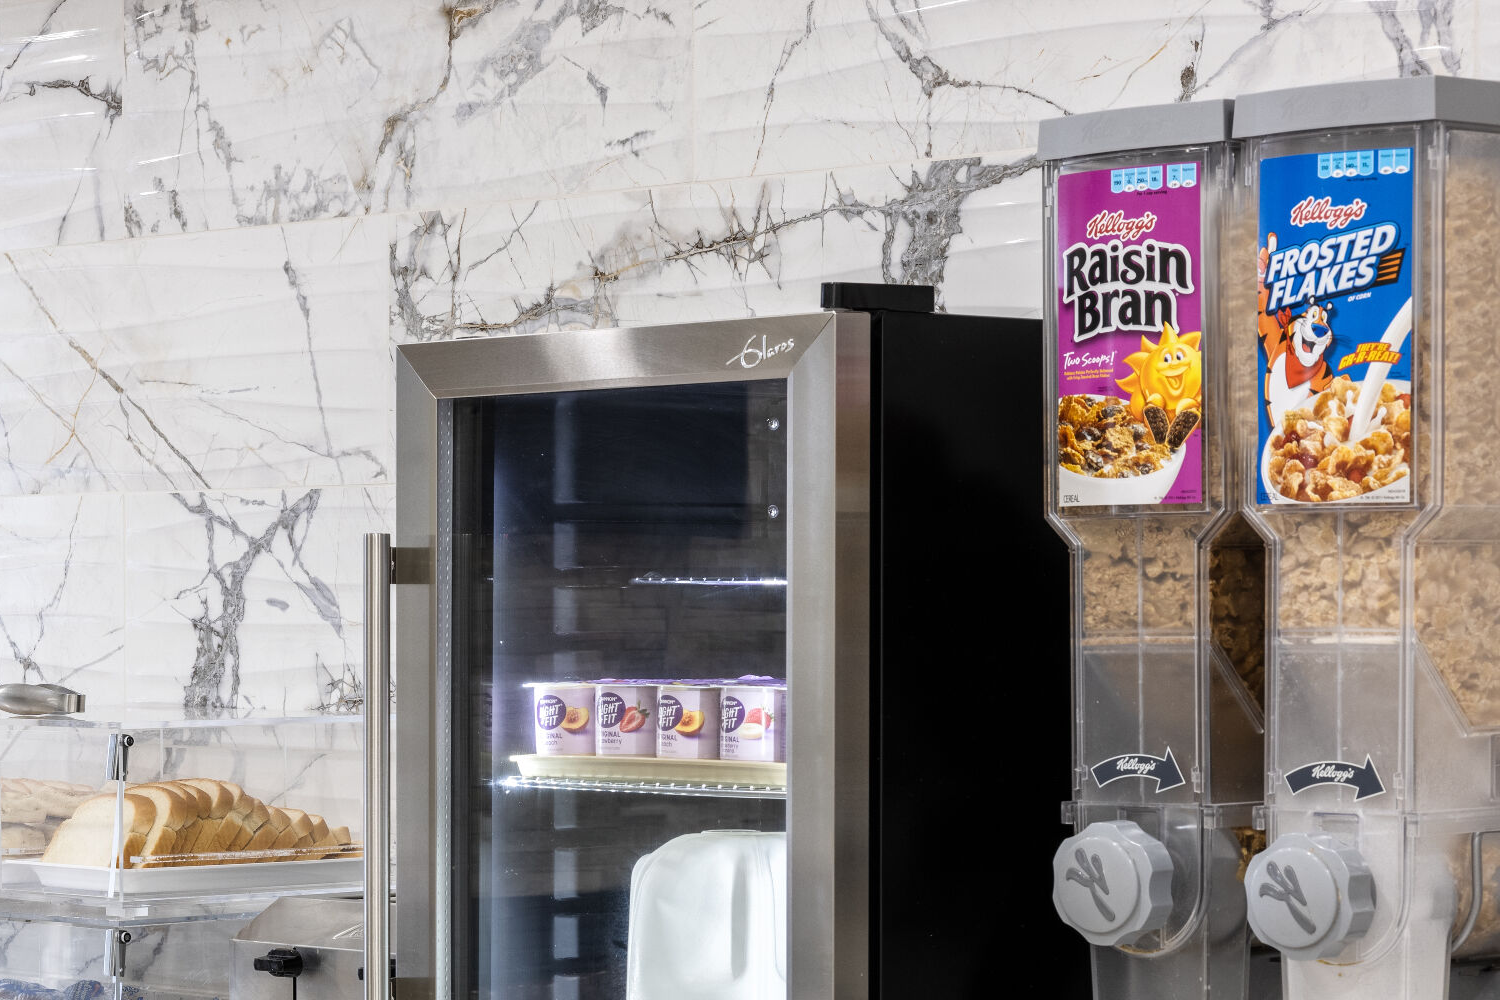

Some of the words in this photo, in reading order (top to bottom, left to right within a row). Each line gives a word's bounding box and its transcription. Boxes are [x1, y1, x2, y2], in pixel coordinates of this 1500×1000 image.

[1087, 210, 1157, 240] Kellogg's
[1290, 196, 1367, 229] Kellogg's
[1266, 223, 1397, 284] FROSTED
[1064, 241, 1192, 301] Raisin
[1268, 255, 1377, 312] FLAKES
[1076, 288, 1176, 339] Bran
[1063, 351, 1081, 370] Two
[1081, 351, 1115, 367] Scoops!
[1063, 494, 1081, 504] CEREAL
[1116, 756, 1156, 772] Kellogg's
[1311, 764, 1355, 780] Kellogg's
